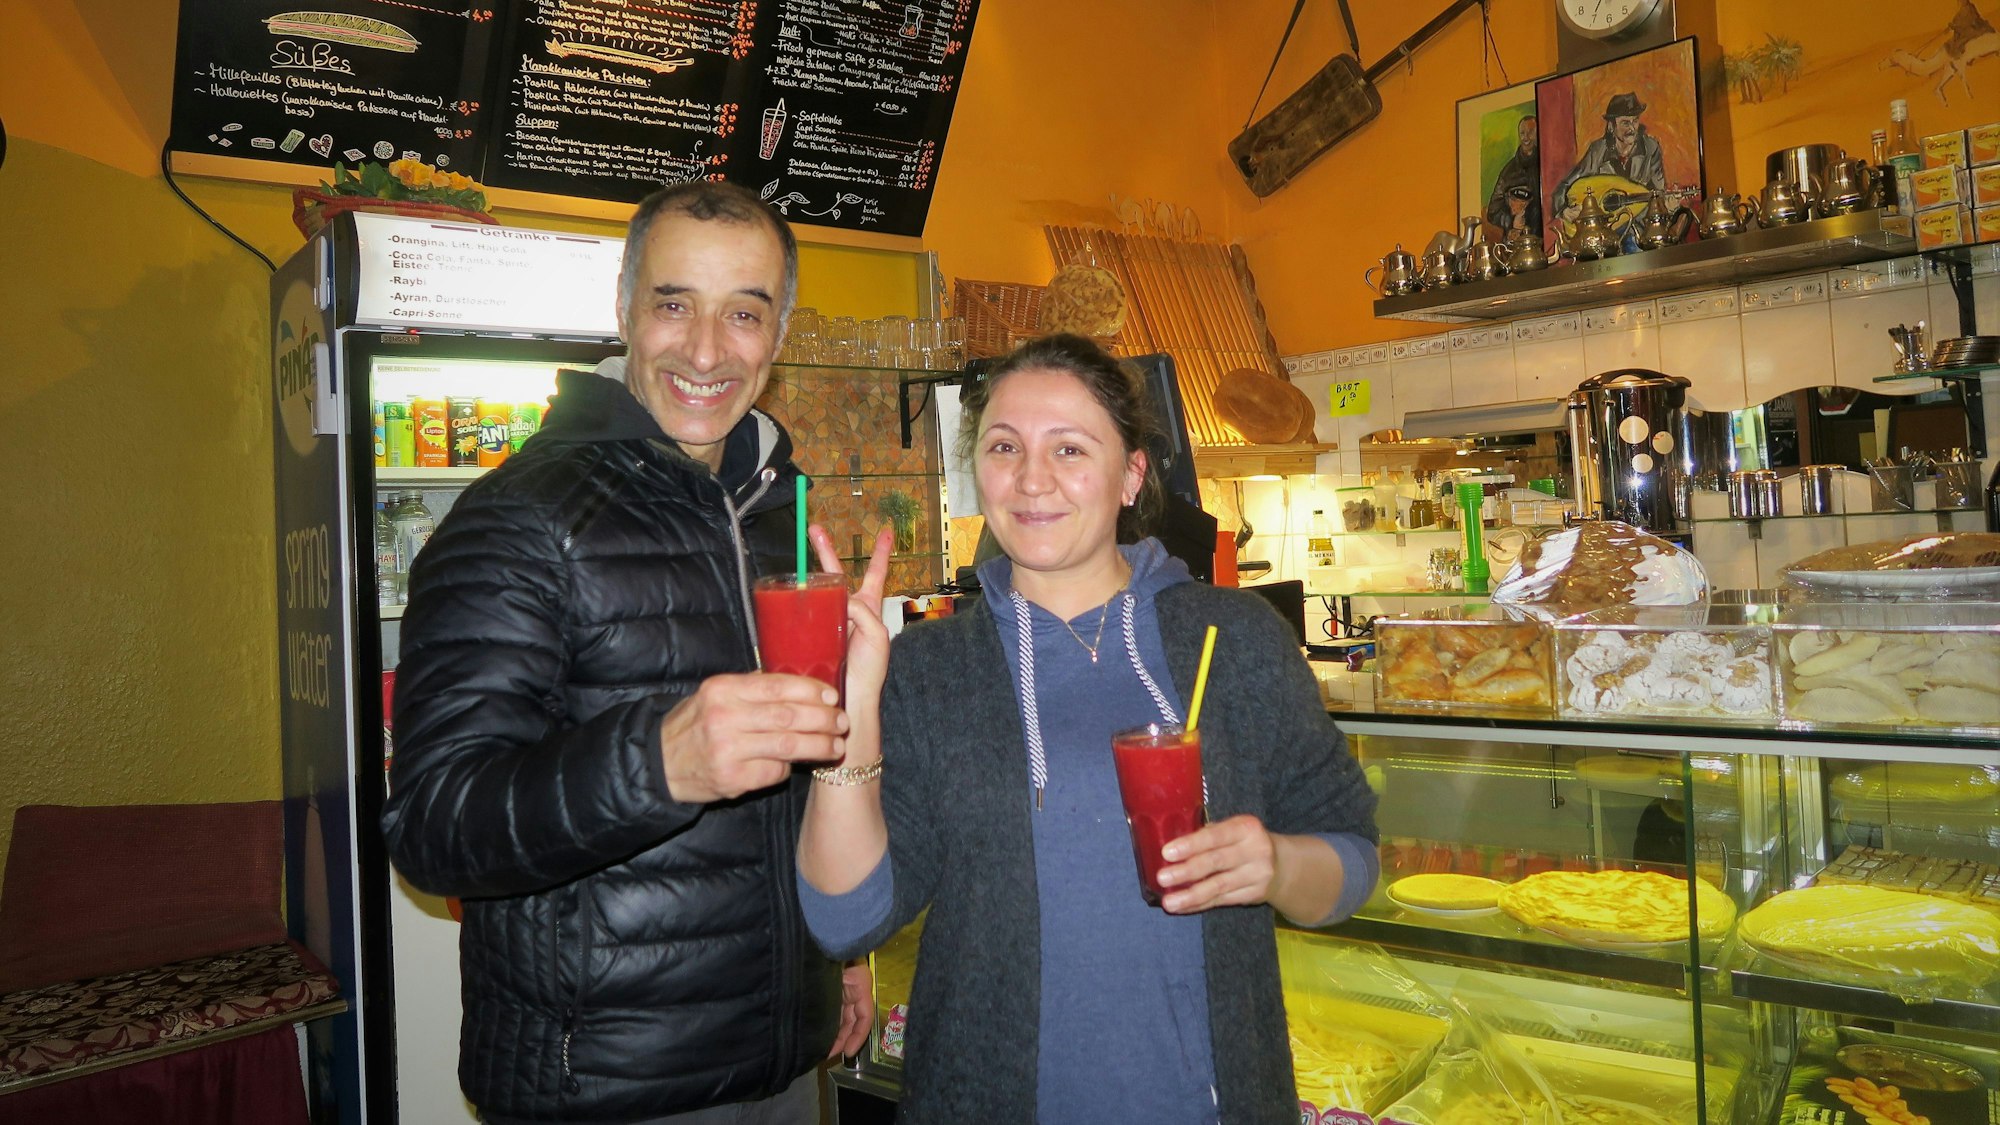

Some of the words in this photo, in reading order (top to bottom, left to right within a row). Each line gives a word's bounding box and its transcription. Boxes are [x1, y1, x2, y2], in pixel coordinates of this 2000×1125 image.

[1578, 6, 1585, 15] 8
[1621, 6, 1628, 15] 5
[1591, 14, 1598, 24] 7
[1606, 14, 1613, 23] 6
[537, 16, 578, 31] Omelette
[580, 22, 634, 40] Casablanca
[270, 40, 352, 74] Süßes
[777, 39, 804, 54] Frisch
[805, 47, 842, 61] gepresste
[844, 52, 867, 66] Säfte
[209, 62, 281, 85] Millefeuilles
[520, 53, 601, 80] Marokkanische
[602, 69, 652, 88] Pasteten:
[522, 75, 561, 91] Pastilla
[564, 82, 612, 98] Hähnchen
[522, 88, 561, 102] Pastilla
[523, 99, 572, 114] Minipastilla
[400, 111, 417, 122] auf
[515, 113, 559, 129] Suppen:
[799, 110, 842, 126] Softdrinks
[515, 131, 551, 144] Bissara
[516, 151, 545, 163] Harira
[1336, 382, 1360, 393] BROT
[426, 428, 444, 436] Lipton
[288, 629, 332, 709] water
